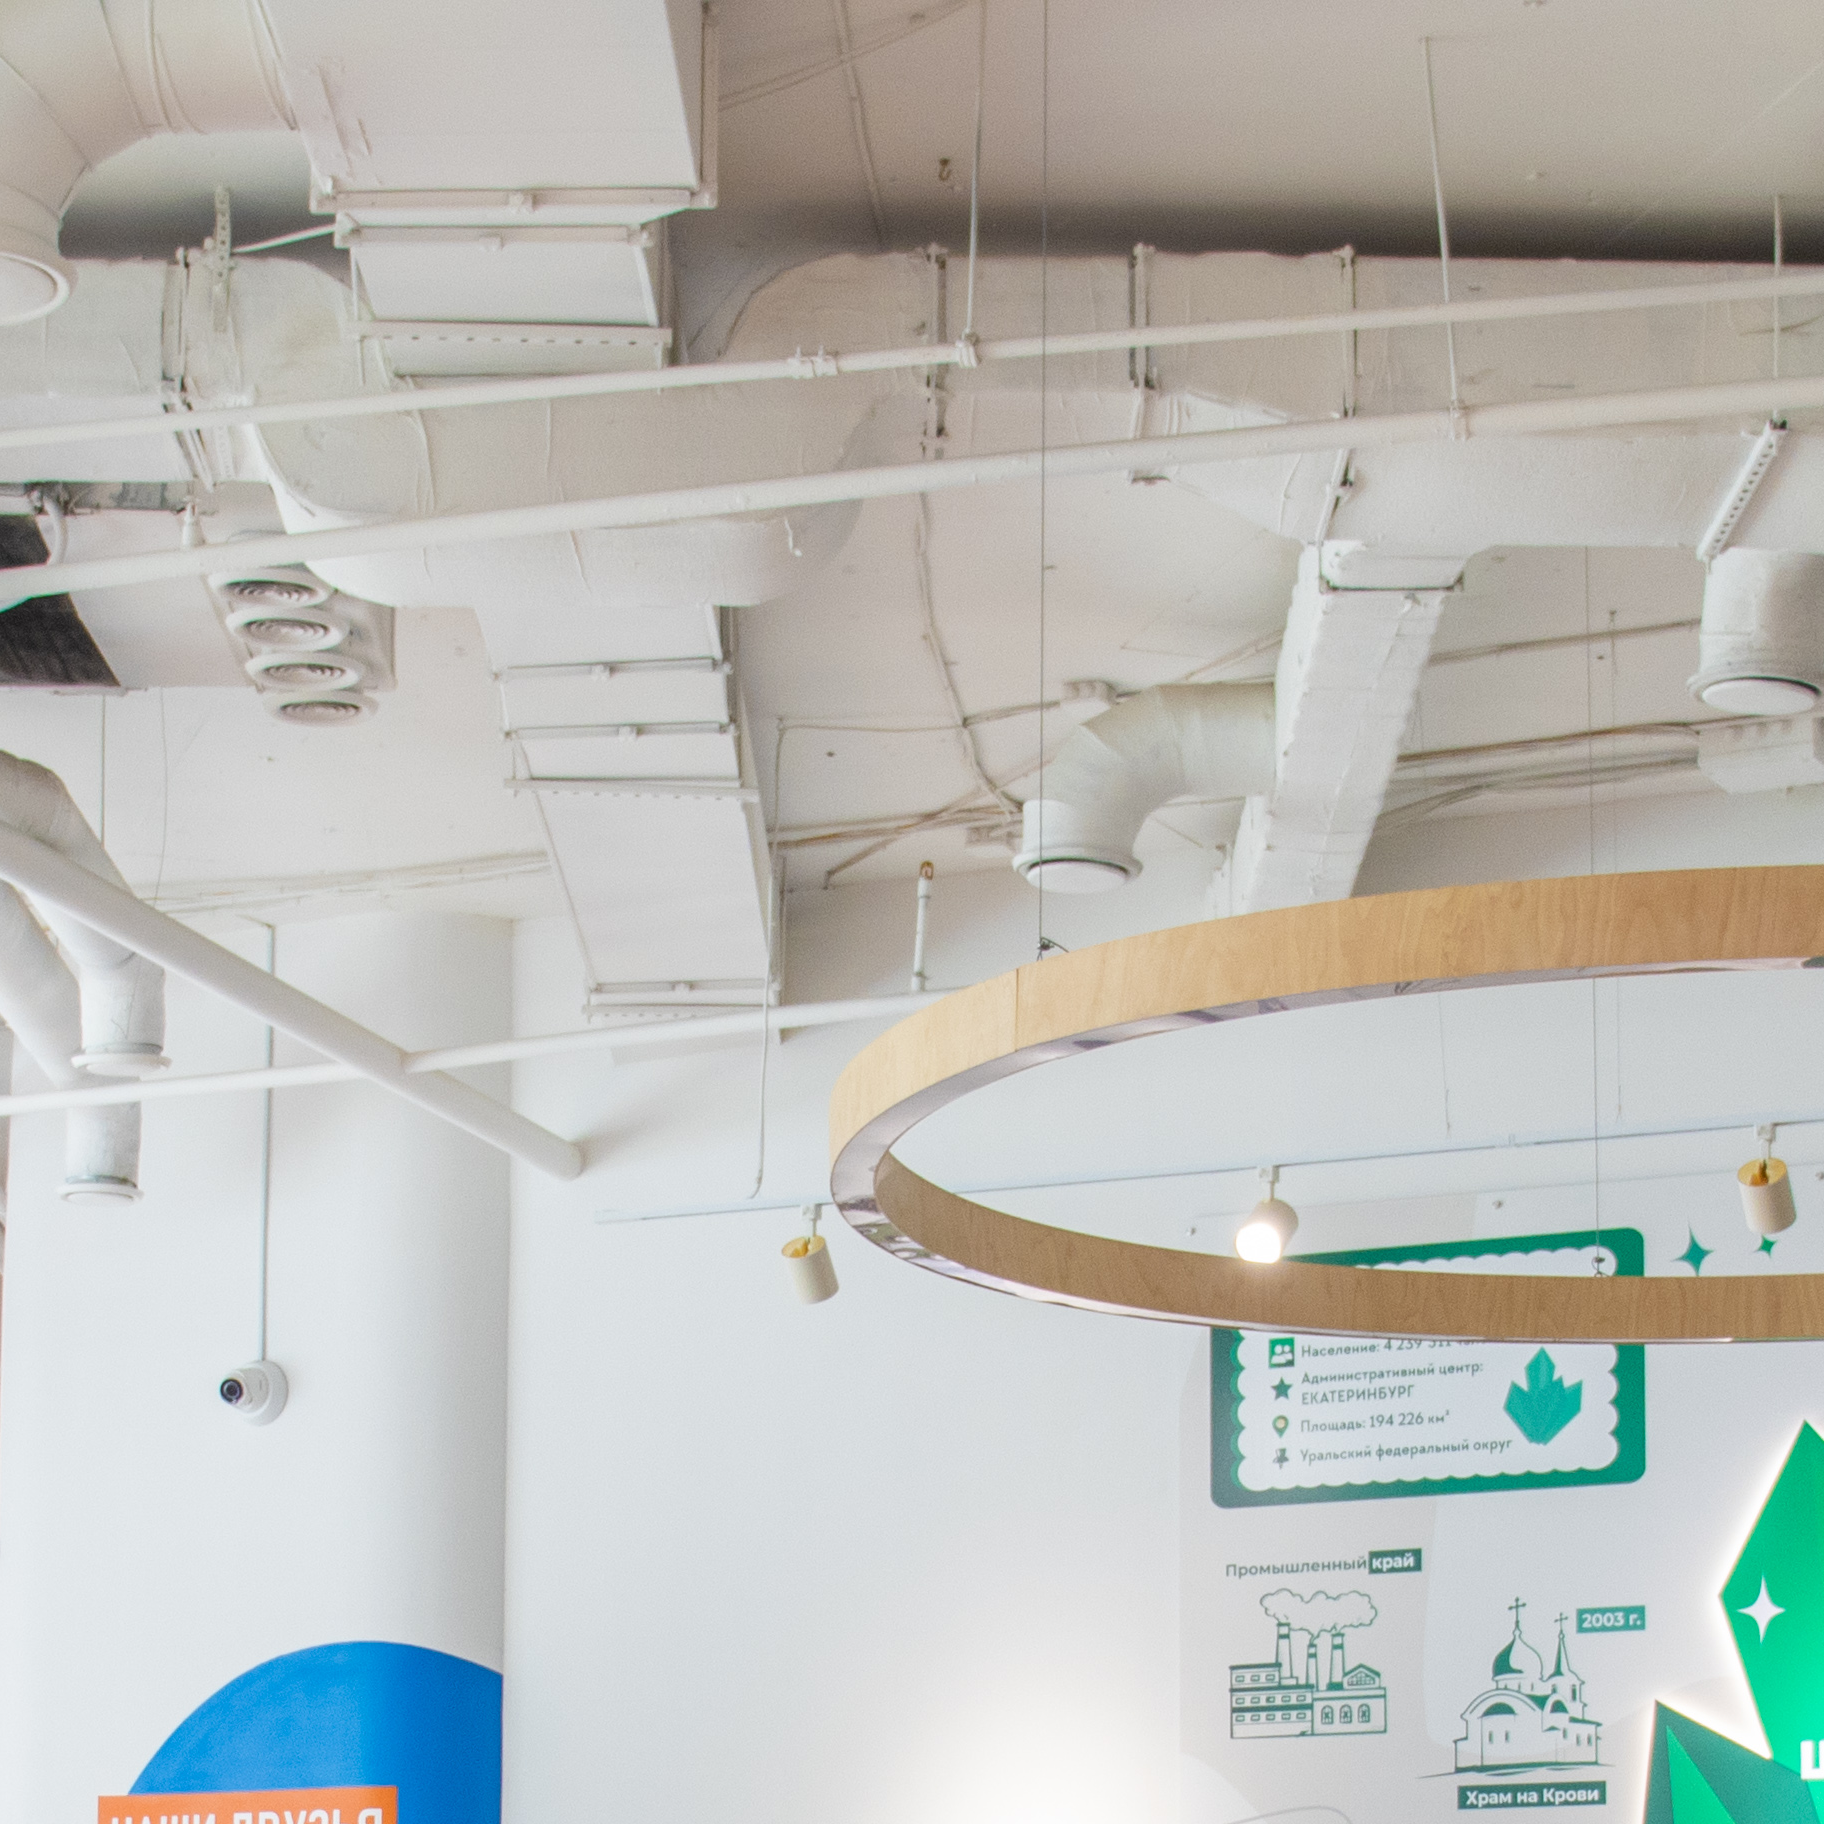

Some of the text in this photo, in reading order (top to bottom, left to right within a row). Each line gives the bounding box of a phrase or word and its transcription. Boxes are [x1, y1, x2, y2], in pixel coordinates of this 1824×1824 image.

[1301, 1343, 1380, 1358] Население:
[1301, 1362, 1484, 1385] Административный центр:
[1301, 1385, 1415, 1406] ЕКАТЕРИНБУРГ
[1301, 1419, 1366, 1434] Площадь:
[1369, 1415, 1395, 1428] 194
[1397, 1412, 1424, 1426] 226
[1300, 1439, 1514, 1466] Уральский федеральный округ
[1225, 1552, 1415, 1579] Промышленный край
[1581, 1612, 1642, 1629] 2003 г.
[1465, 1786, 1600, 1807] Храм на Крови
